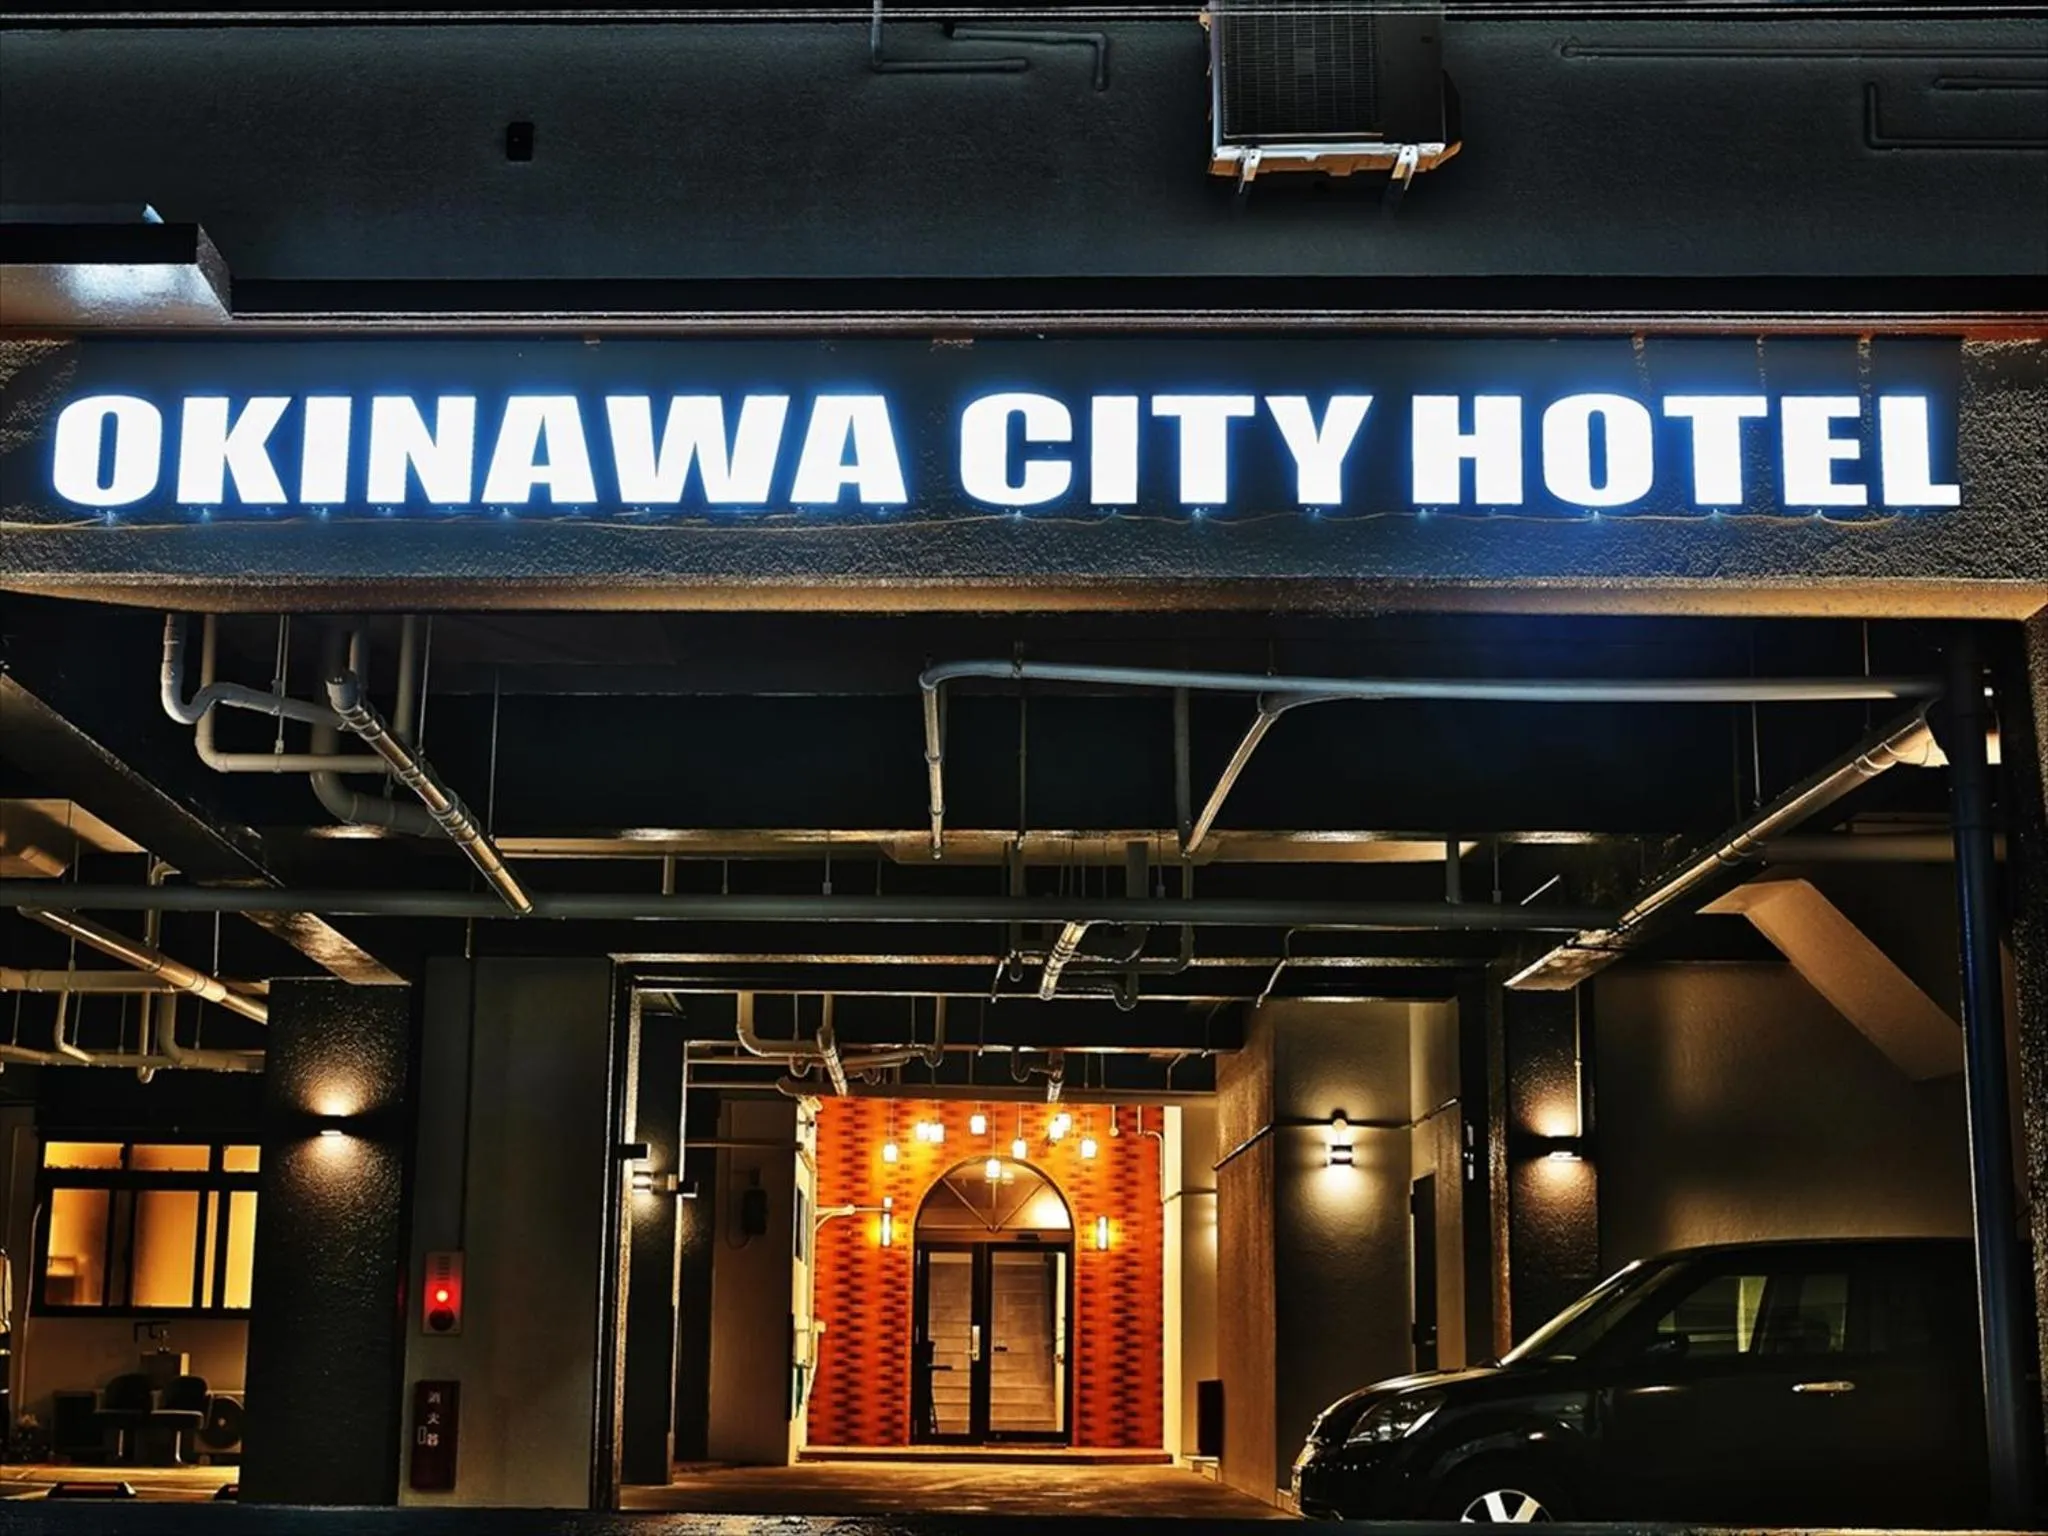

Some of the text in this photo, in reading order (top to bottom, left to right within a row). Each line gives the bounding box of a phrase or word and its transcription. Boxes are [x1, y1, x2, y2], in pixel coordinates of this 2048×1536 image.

[52, 392, 1961, 508] OKINAWA CITY HOTEL
